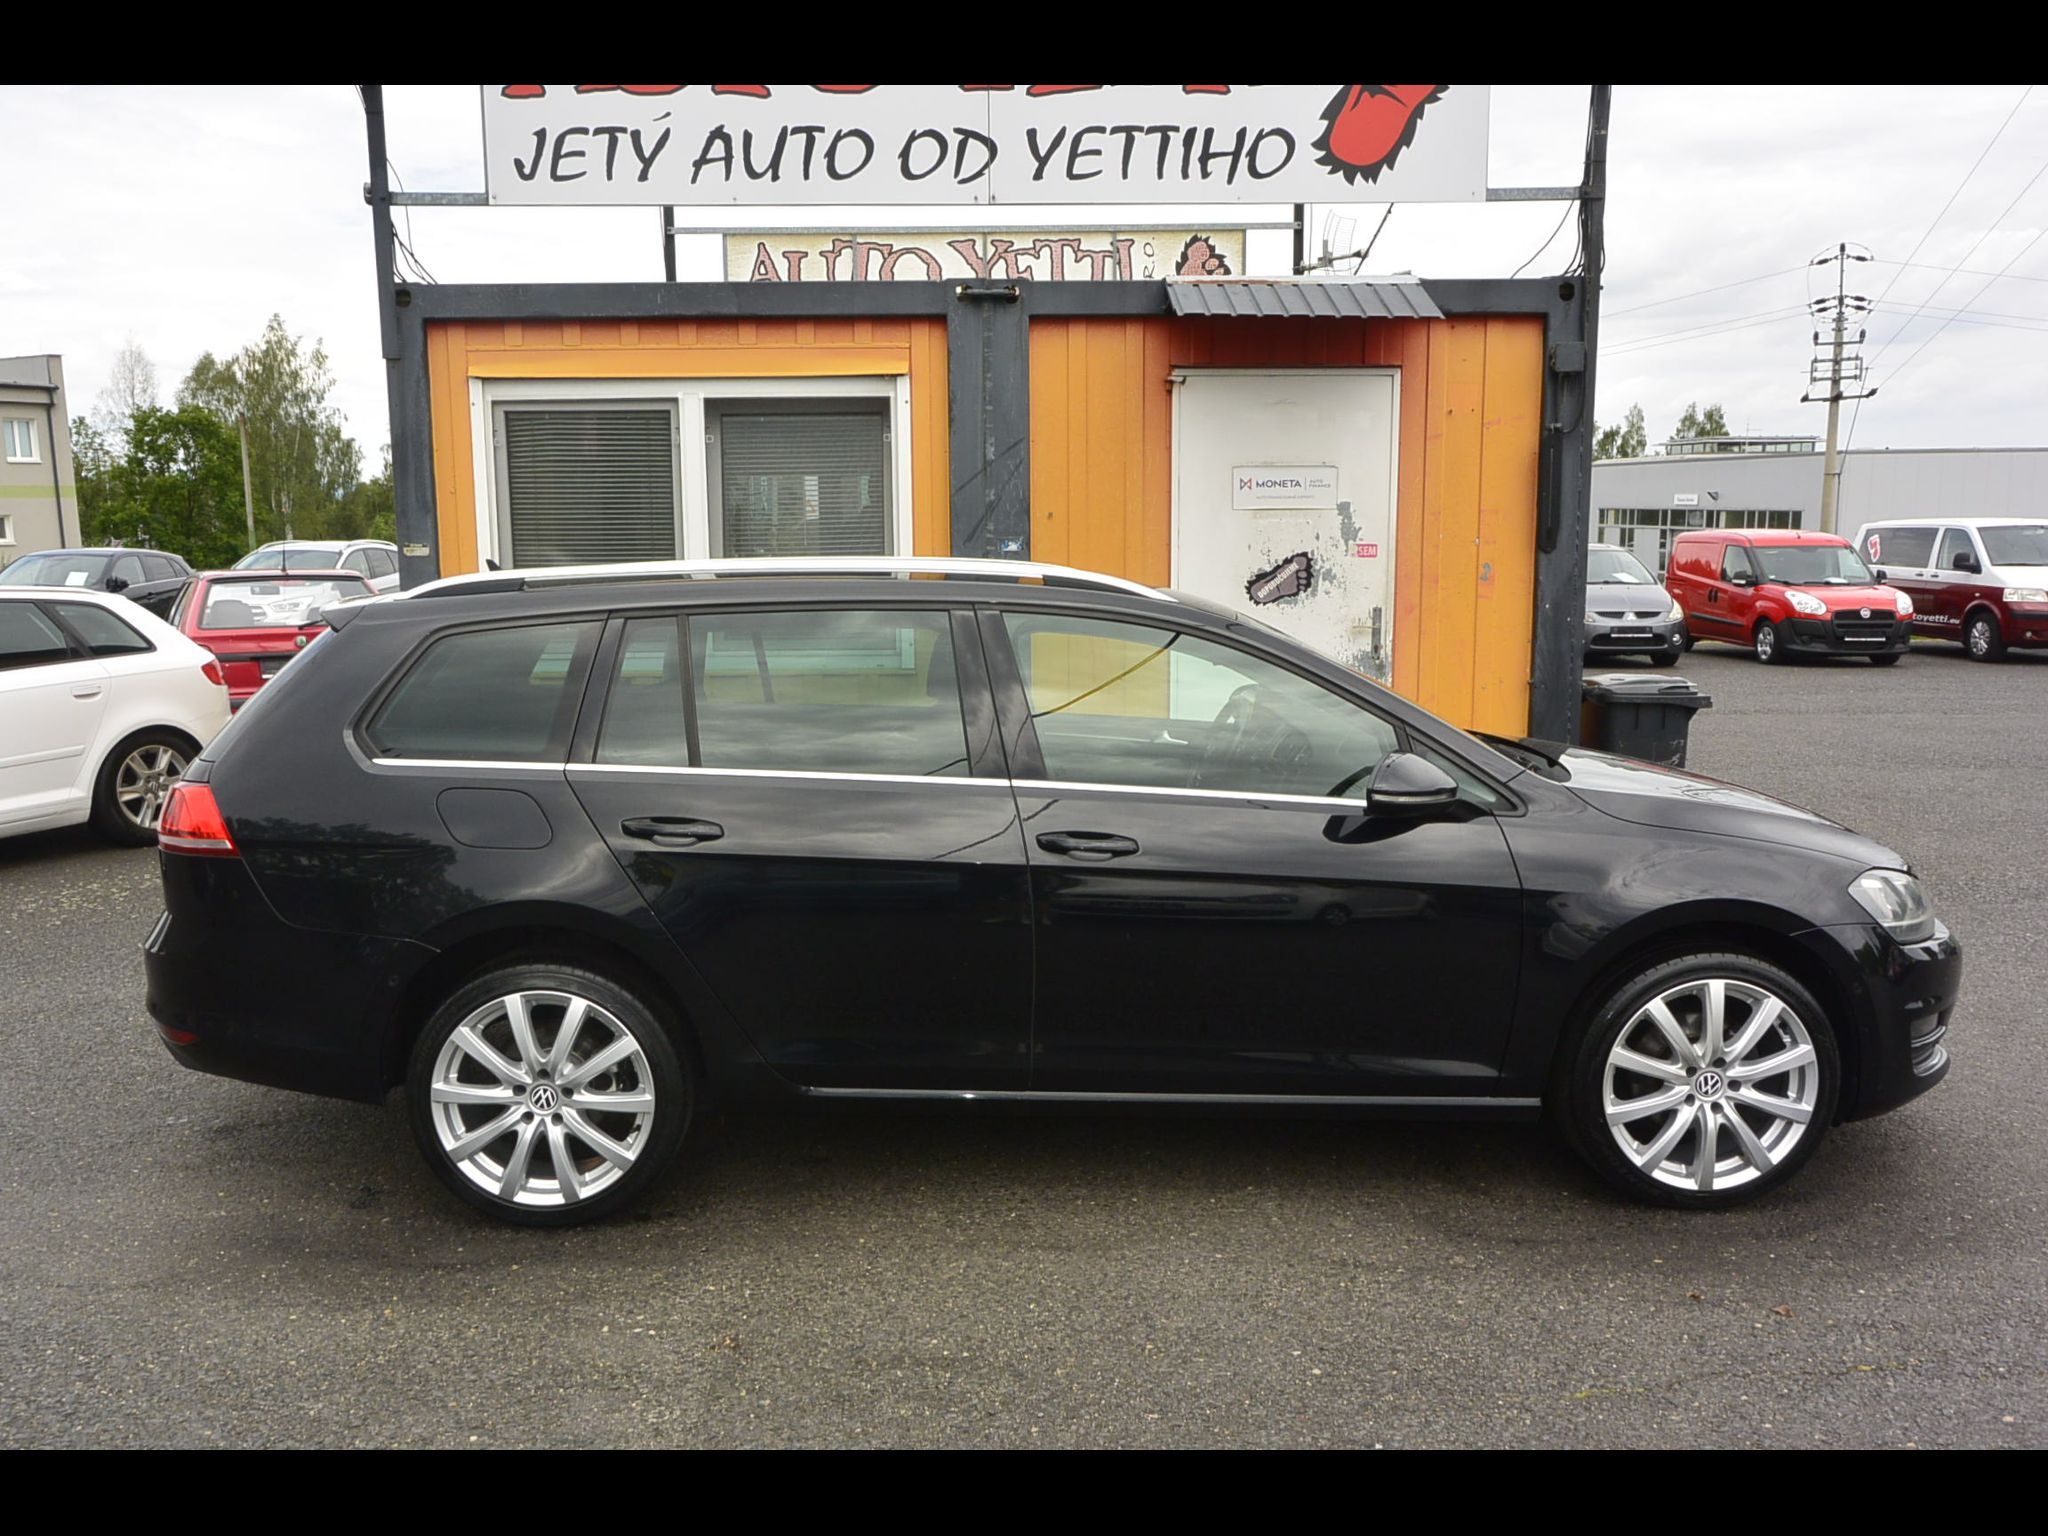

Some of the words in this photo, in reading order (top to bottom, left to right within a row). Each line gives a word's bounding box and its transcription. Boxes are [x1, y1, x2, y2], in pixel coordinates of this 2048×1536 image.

[513, 111, 672, 182] JETÝ
[690, 124, 875, 185] AUTO
[898, 128, 999, 184] OD
[1025, 125, 1297, 185] YETTIHO
[750, 238, 943, 282] AUTO
[947, 238, 1135, 281] YETTI
[1255, 479, 1302, 489] MONETA
[1358, 546, 1377, 556] SEM
